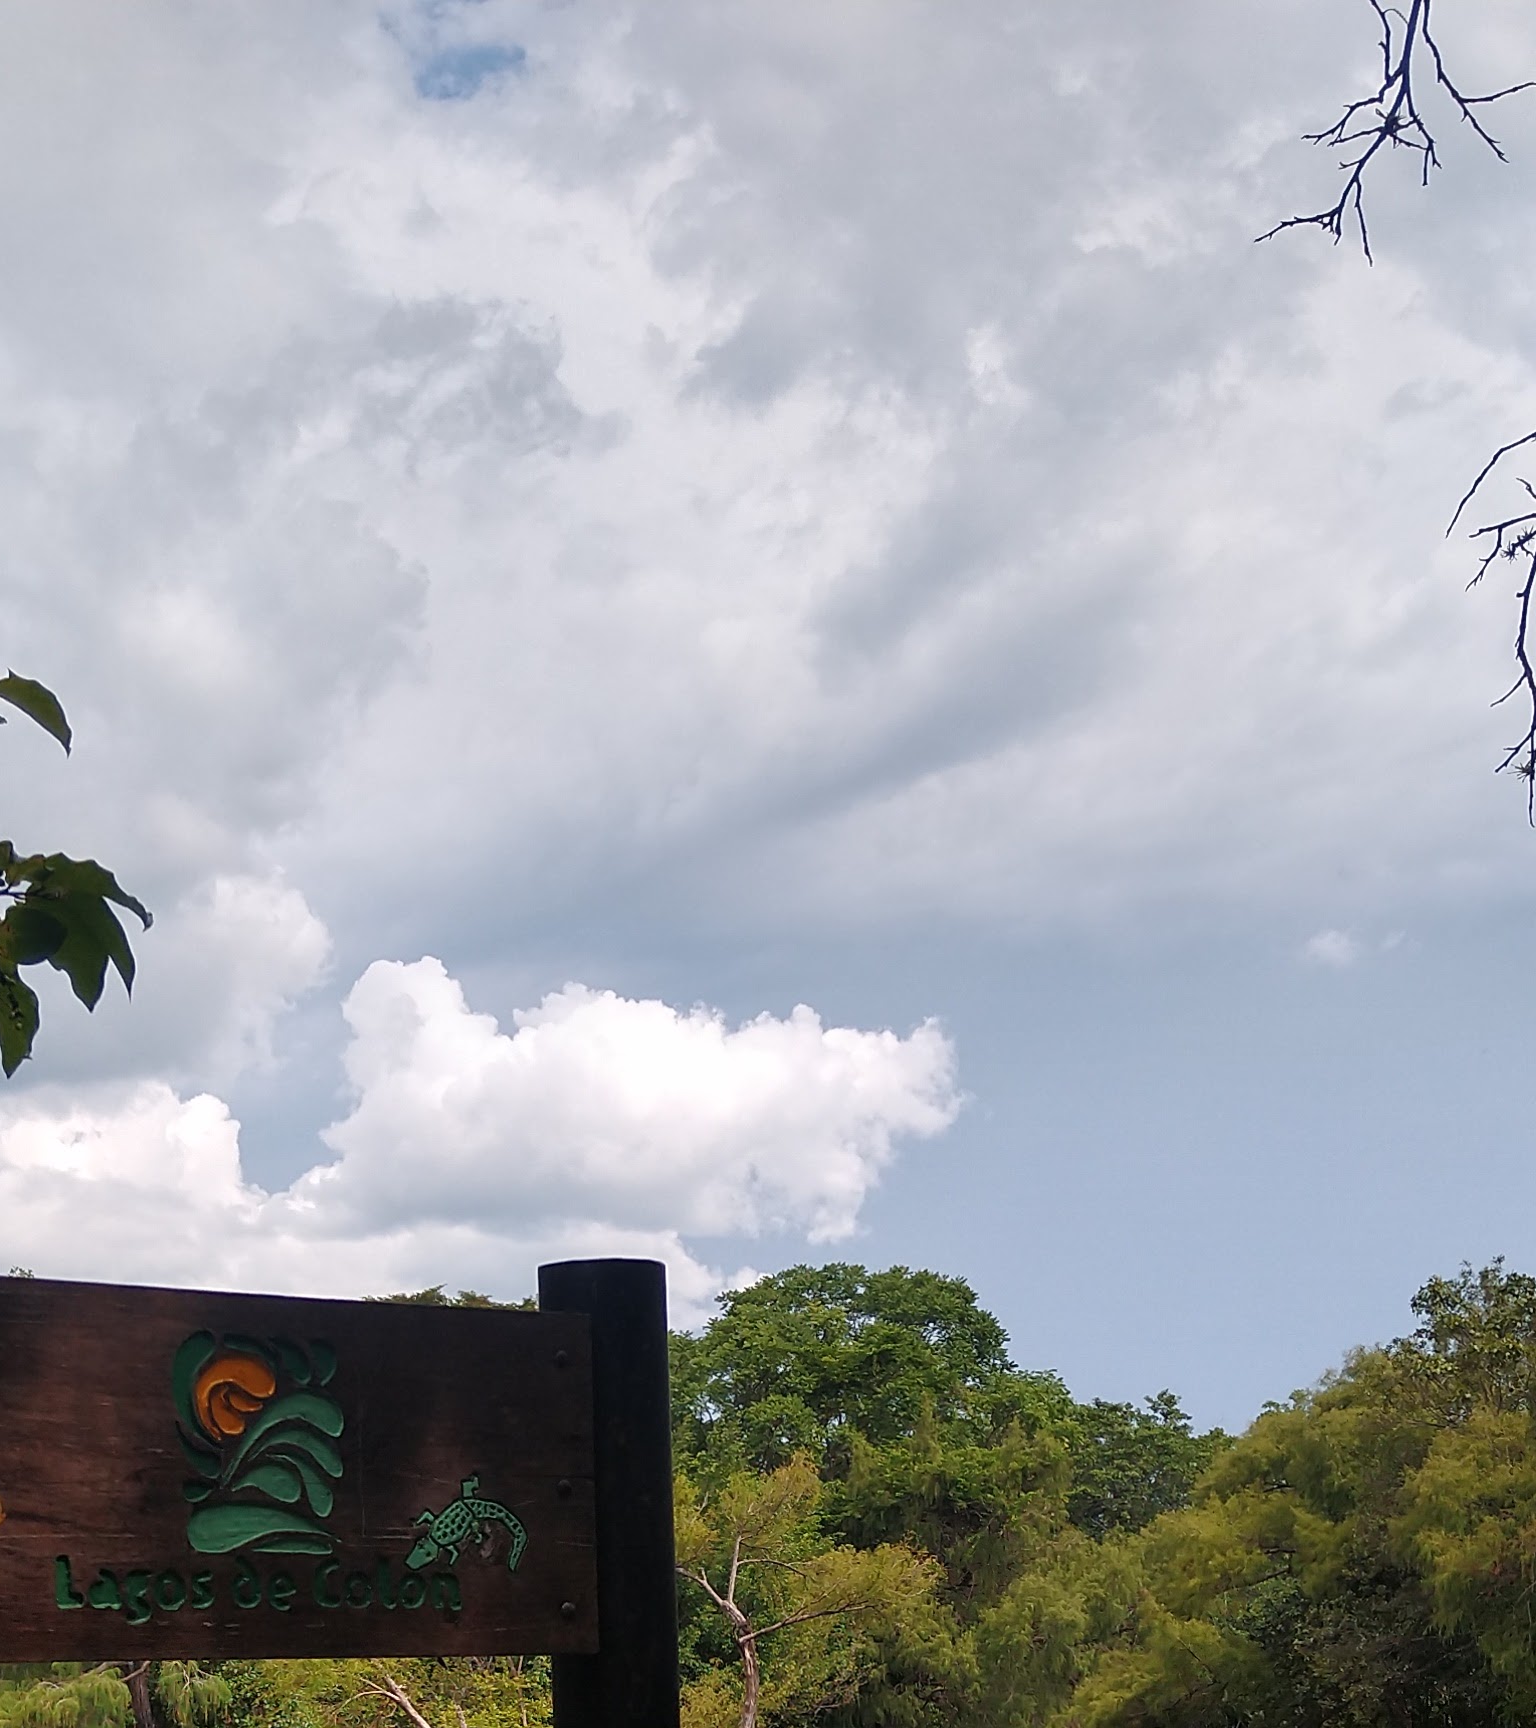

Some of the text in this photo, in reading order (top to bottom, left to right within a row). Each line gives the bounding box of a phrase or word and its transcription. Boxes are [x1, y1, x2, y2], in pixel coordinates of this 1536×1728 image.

[55, 1554, 463, 1626] Lagos de Colon
